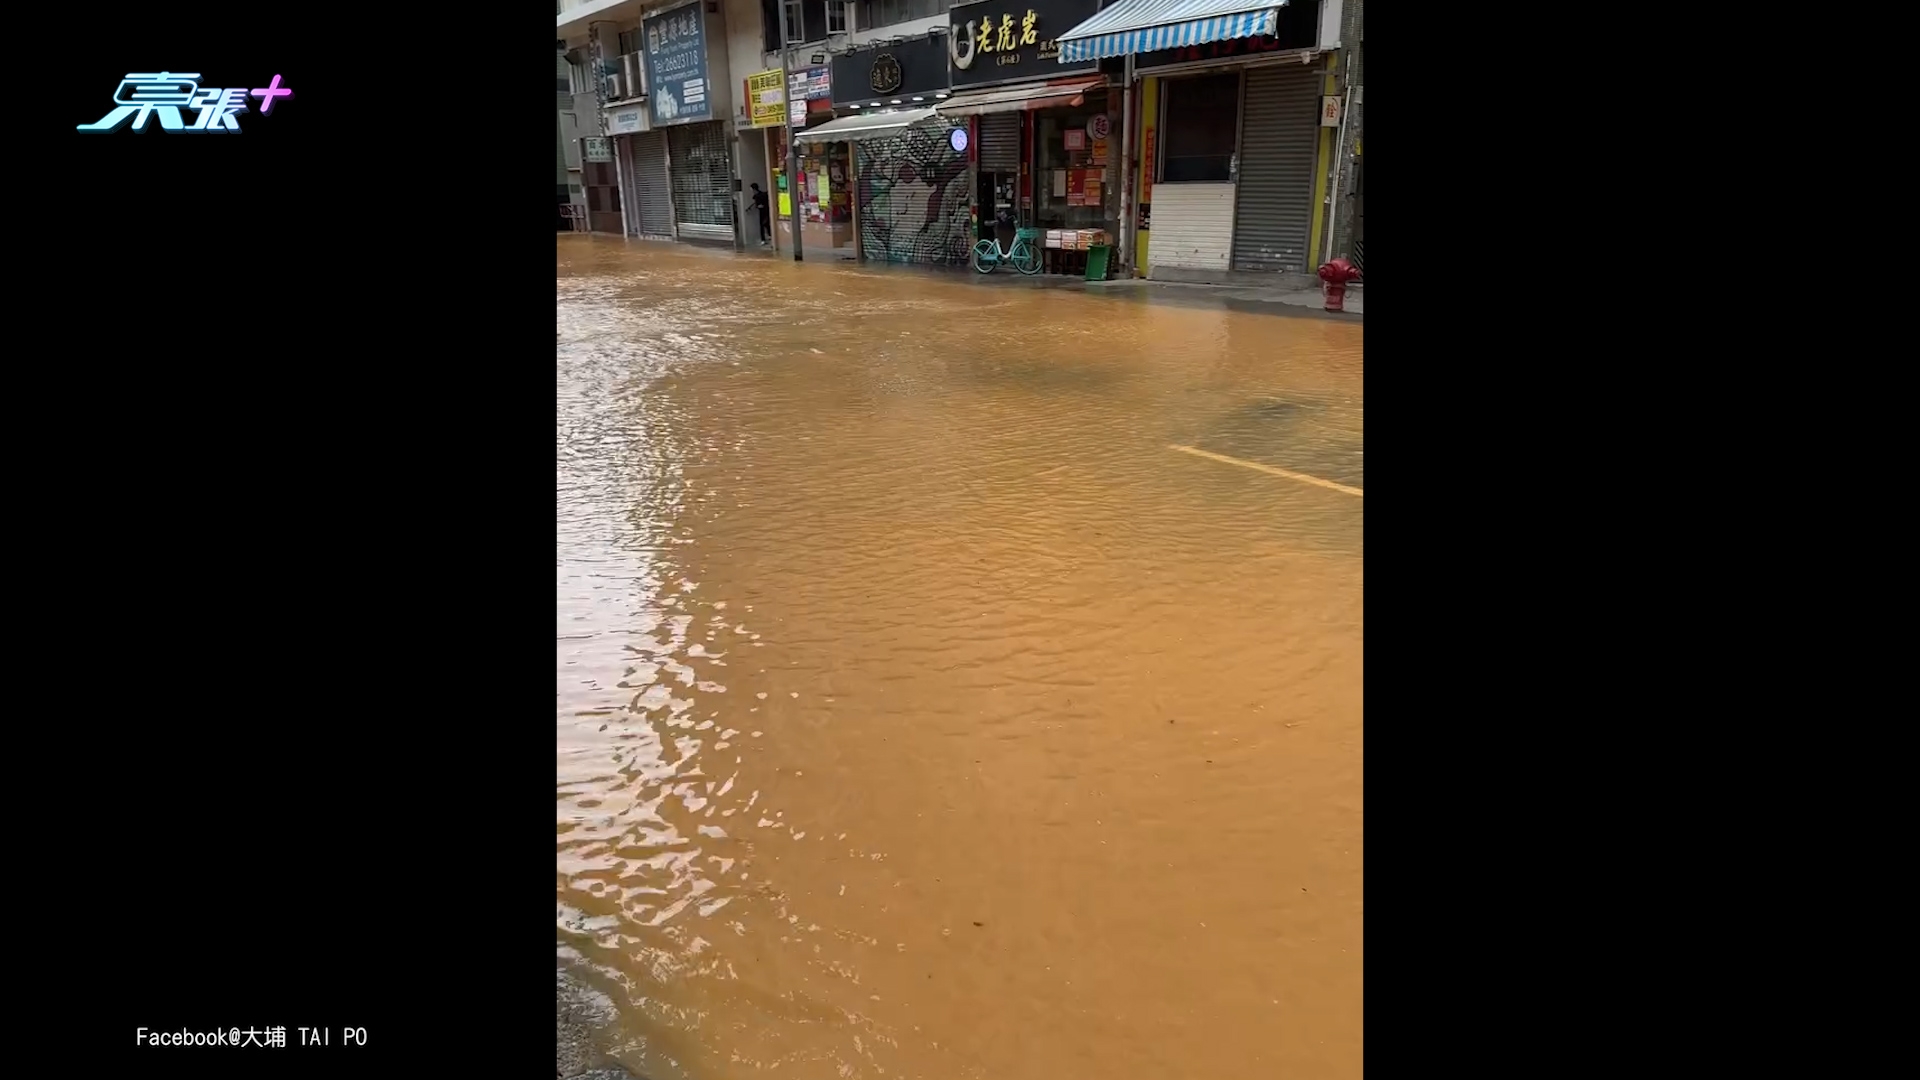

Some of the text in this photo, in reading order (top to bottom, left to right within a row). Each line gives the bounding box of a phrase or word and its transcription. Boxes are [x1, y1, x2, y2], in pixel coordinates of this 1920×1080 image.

[658, 9, 699, 46] 豐源地產
[977, 9, 1039, 54] 老虎岩
